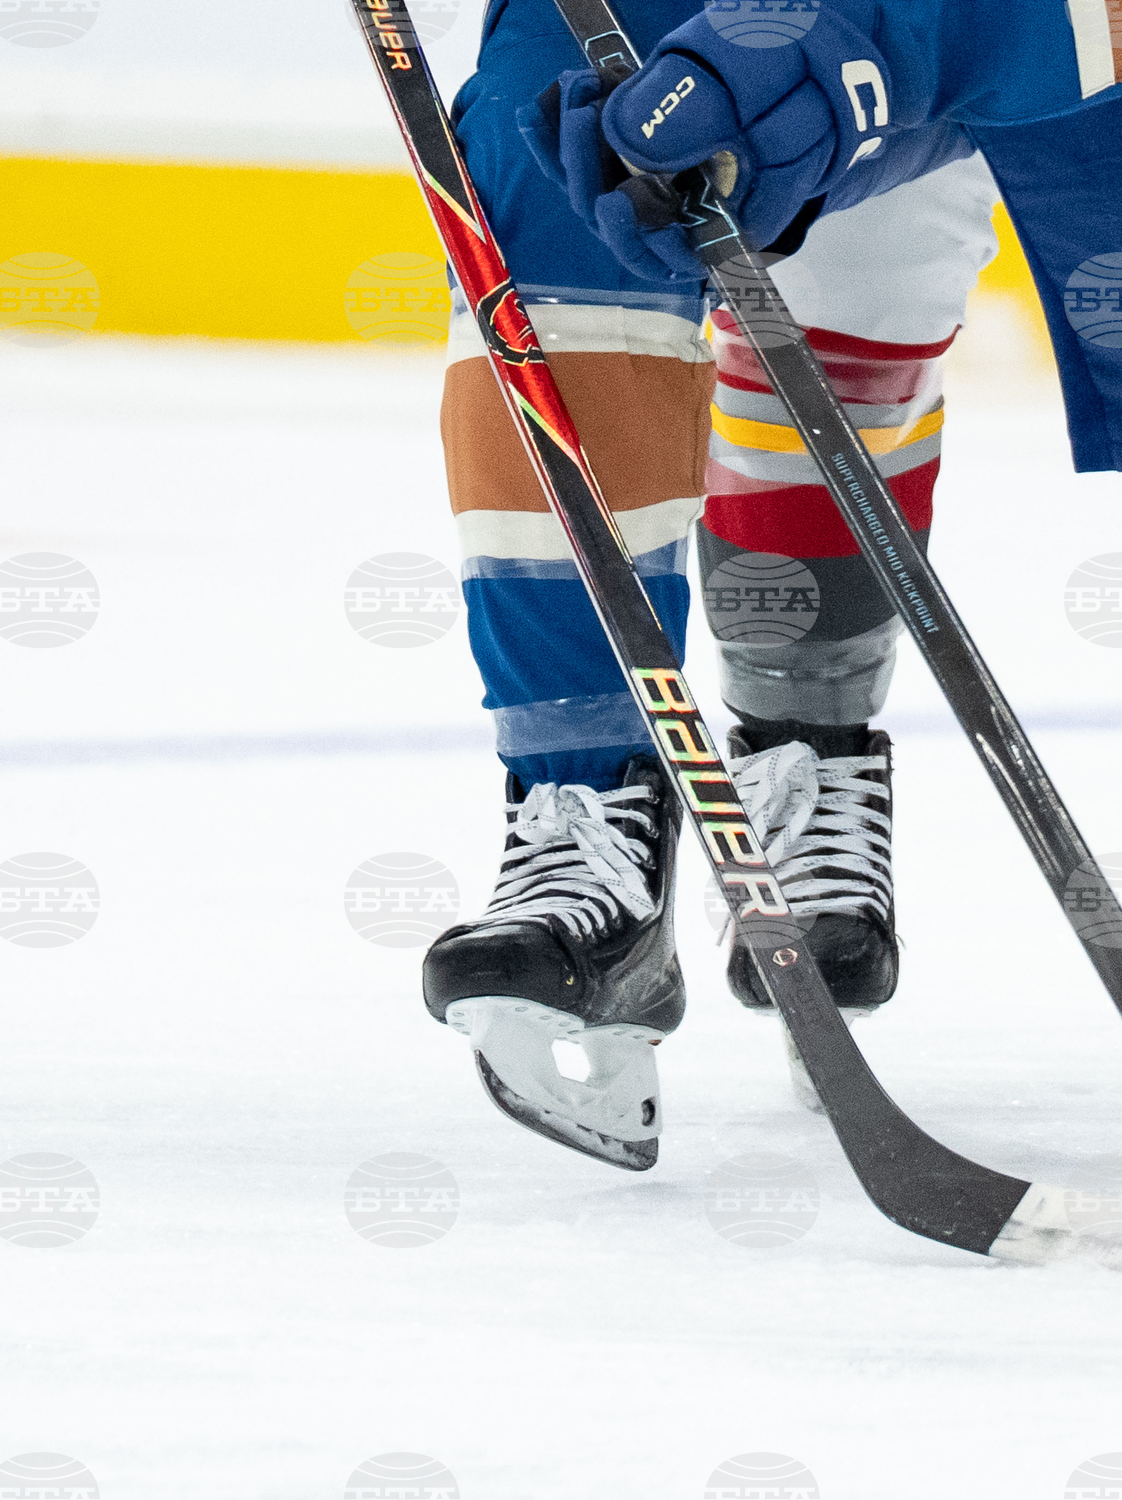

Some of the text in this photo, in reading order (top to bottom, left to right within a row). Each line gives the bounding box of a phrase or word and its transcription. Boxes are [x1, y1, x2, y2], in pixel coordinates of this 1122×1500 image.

[641, 76, 696, 140] CCM
[831, 452, 939, 634] SUPERCHARGED MID KICKPOINT
